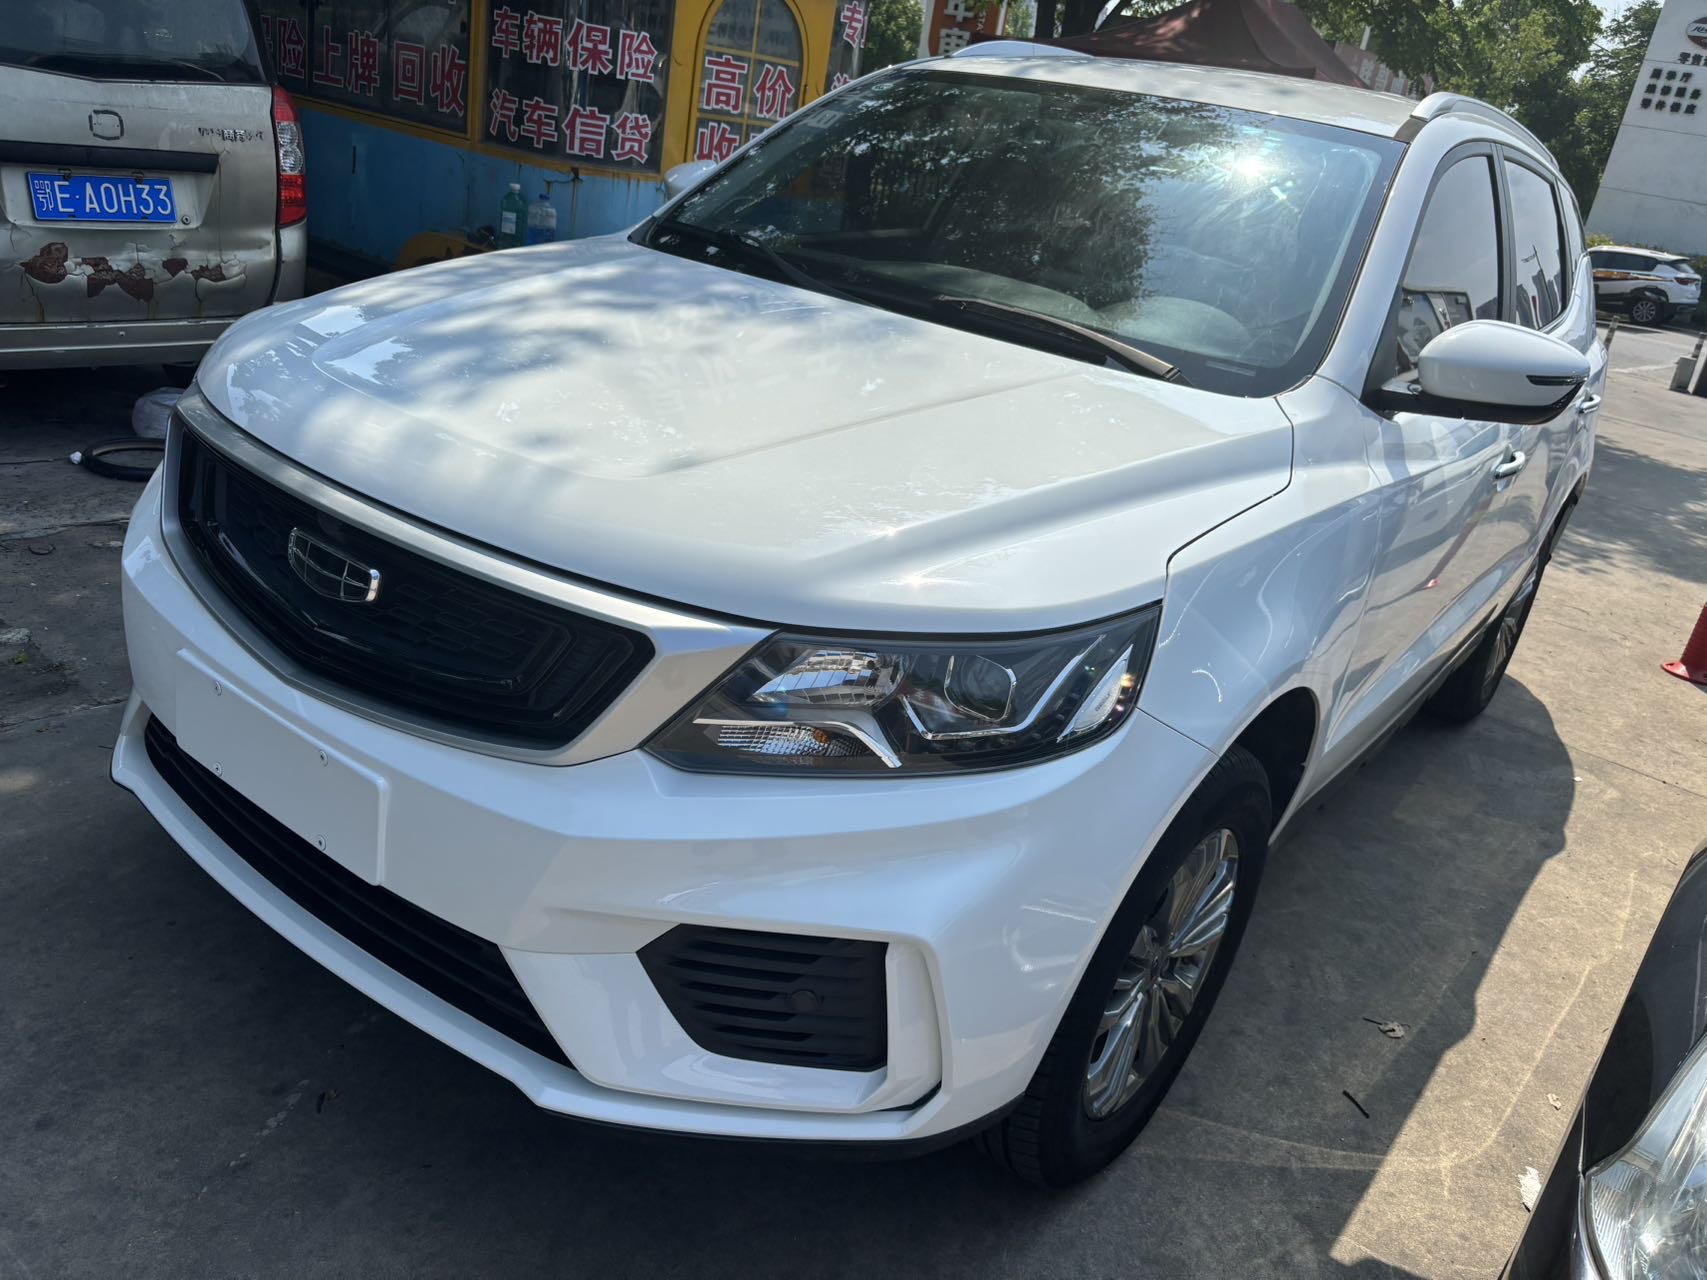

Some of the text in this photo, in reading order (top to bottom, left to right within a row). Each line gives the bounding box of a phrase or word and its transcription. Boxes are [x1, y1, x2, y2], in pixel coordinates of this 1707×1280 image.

[492, 6, 658, 83] 车辆保险
[840, 1, 868, 48] 专
[704, 55, 795, 120] 高价
[490, 88, 652, 164] 汽车信贷
